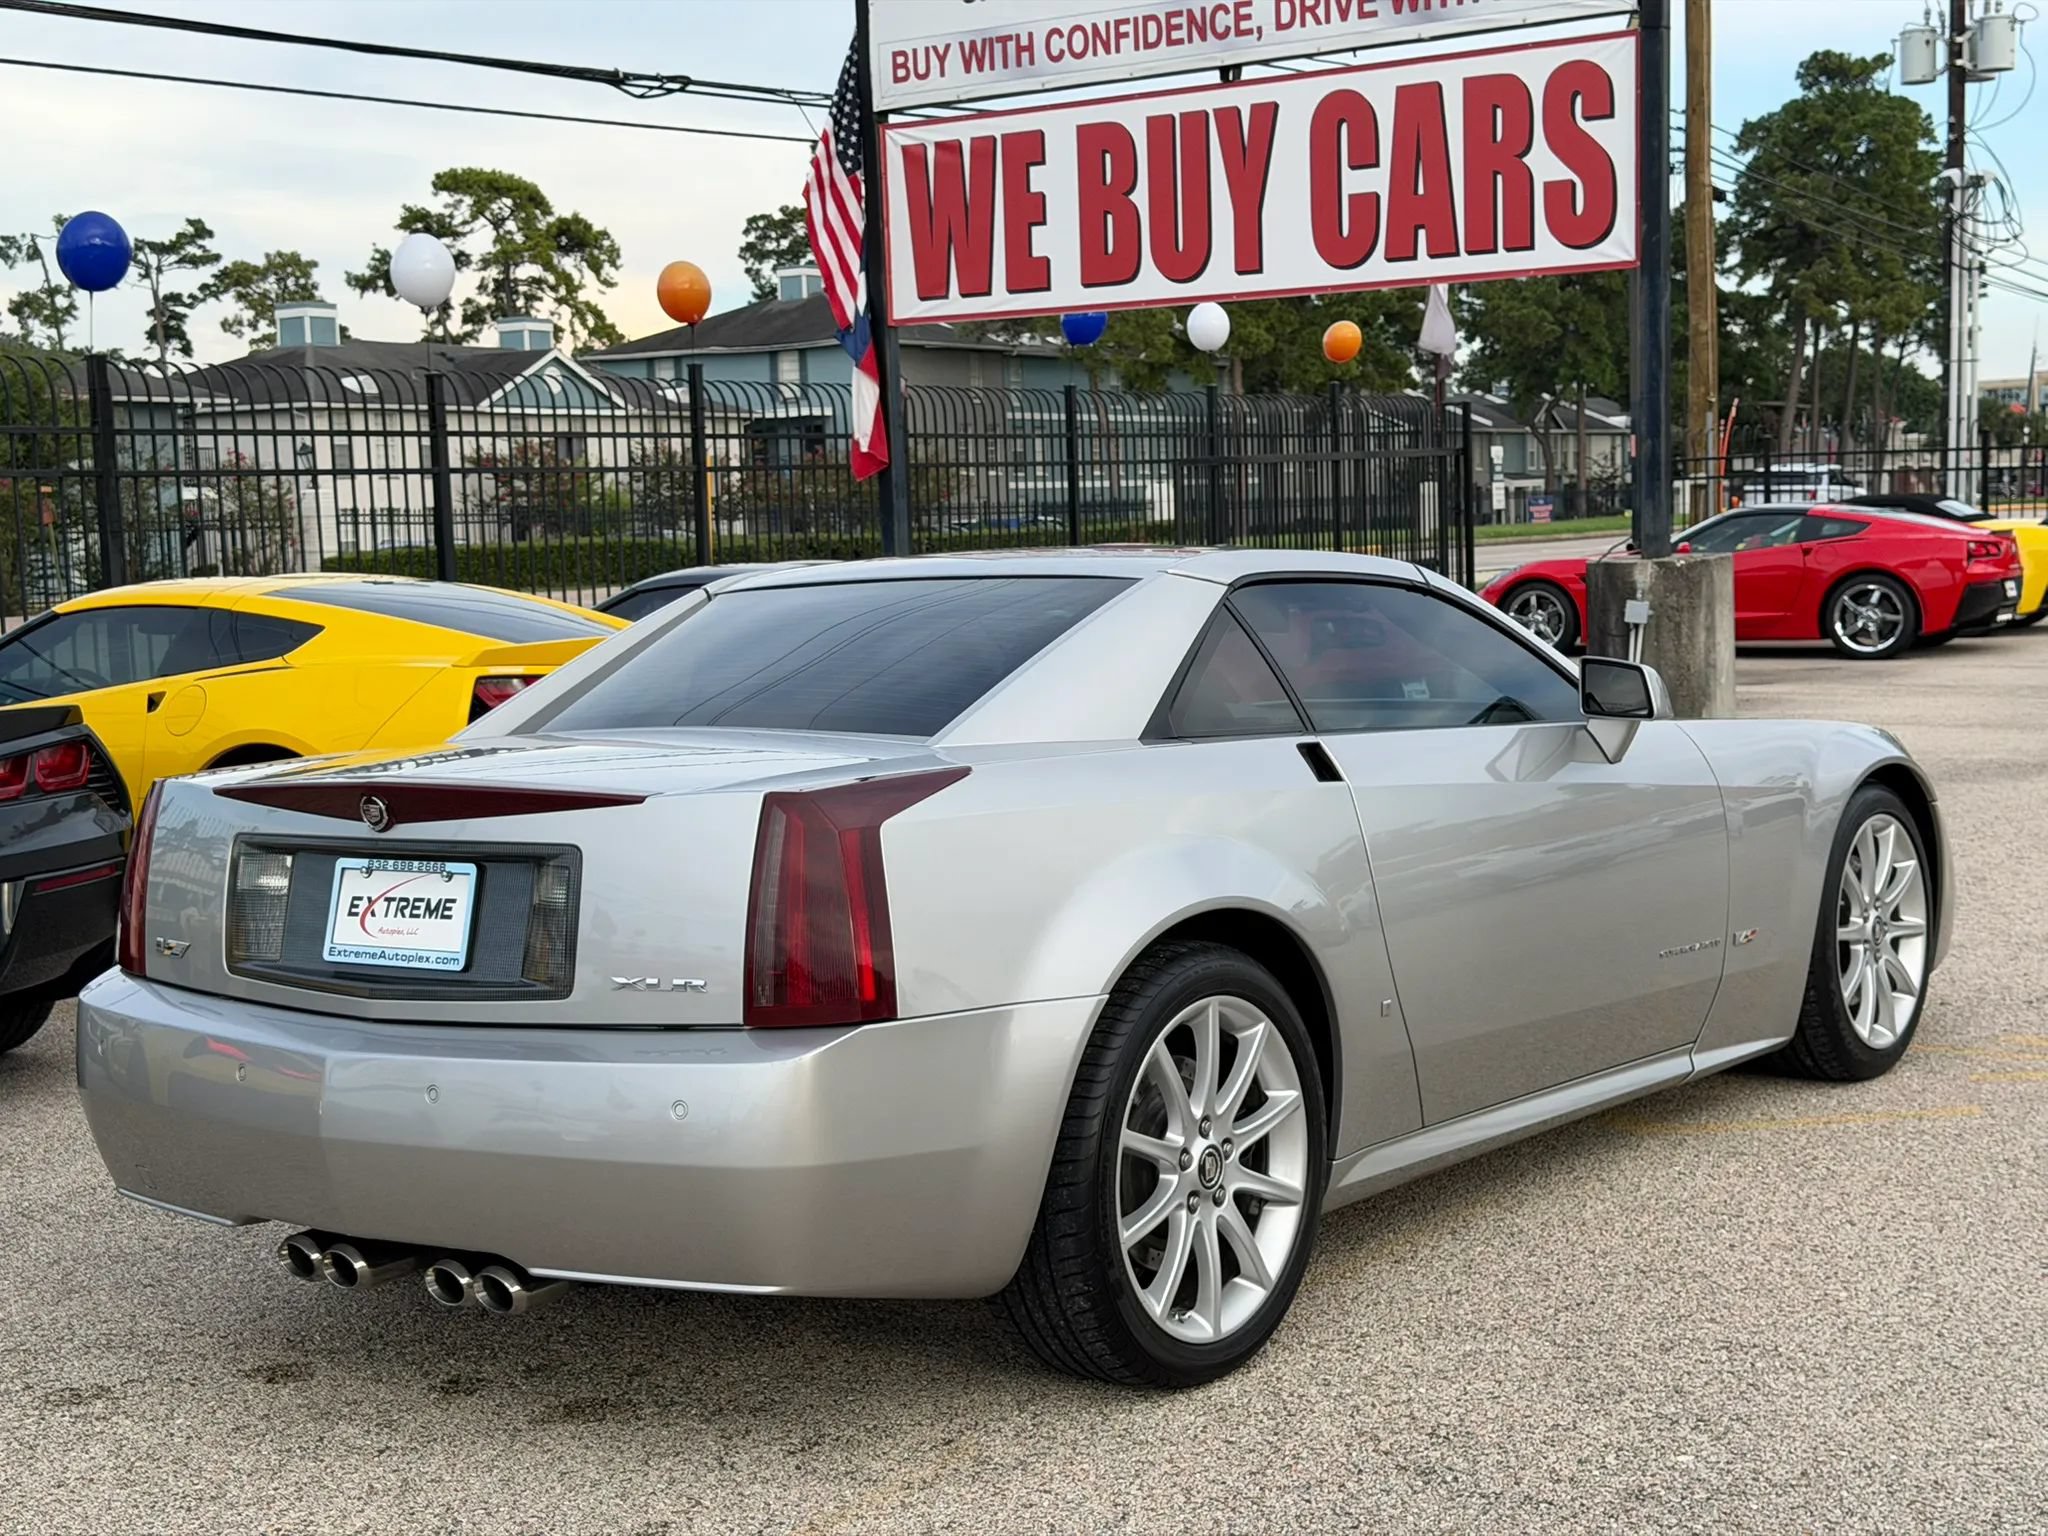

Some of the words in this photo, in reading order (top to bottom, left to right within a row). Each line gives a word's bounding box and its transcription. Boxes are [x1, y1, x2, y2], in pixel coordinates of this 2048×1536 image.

[891, 43, 951, 84] BUY
[959, 31, 1035, 74] WITH
[1045, 1, 1263, 63] CONFIDENCE,
[1274, 0, 1378, 32] DRIVE
[901, 129, 1051, 300] WE
[1076, 101, 1279, 288] BUY
[1310, 59, 1615, 270] CARS
[347, 896, 457, 920] EXTREME
[328, 946, 460, 966] ExtremeAutoplex.com
[610, 976, 707, 993] XLR
